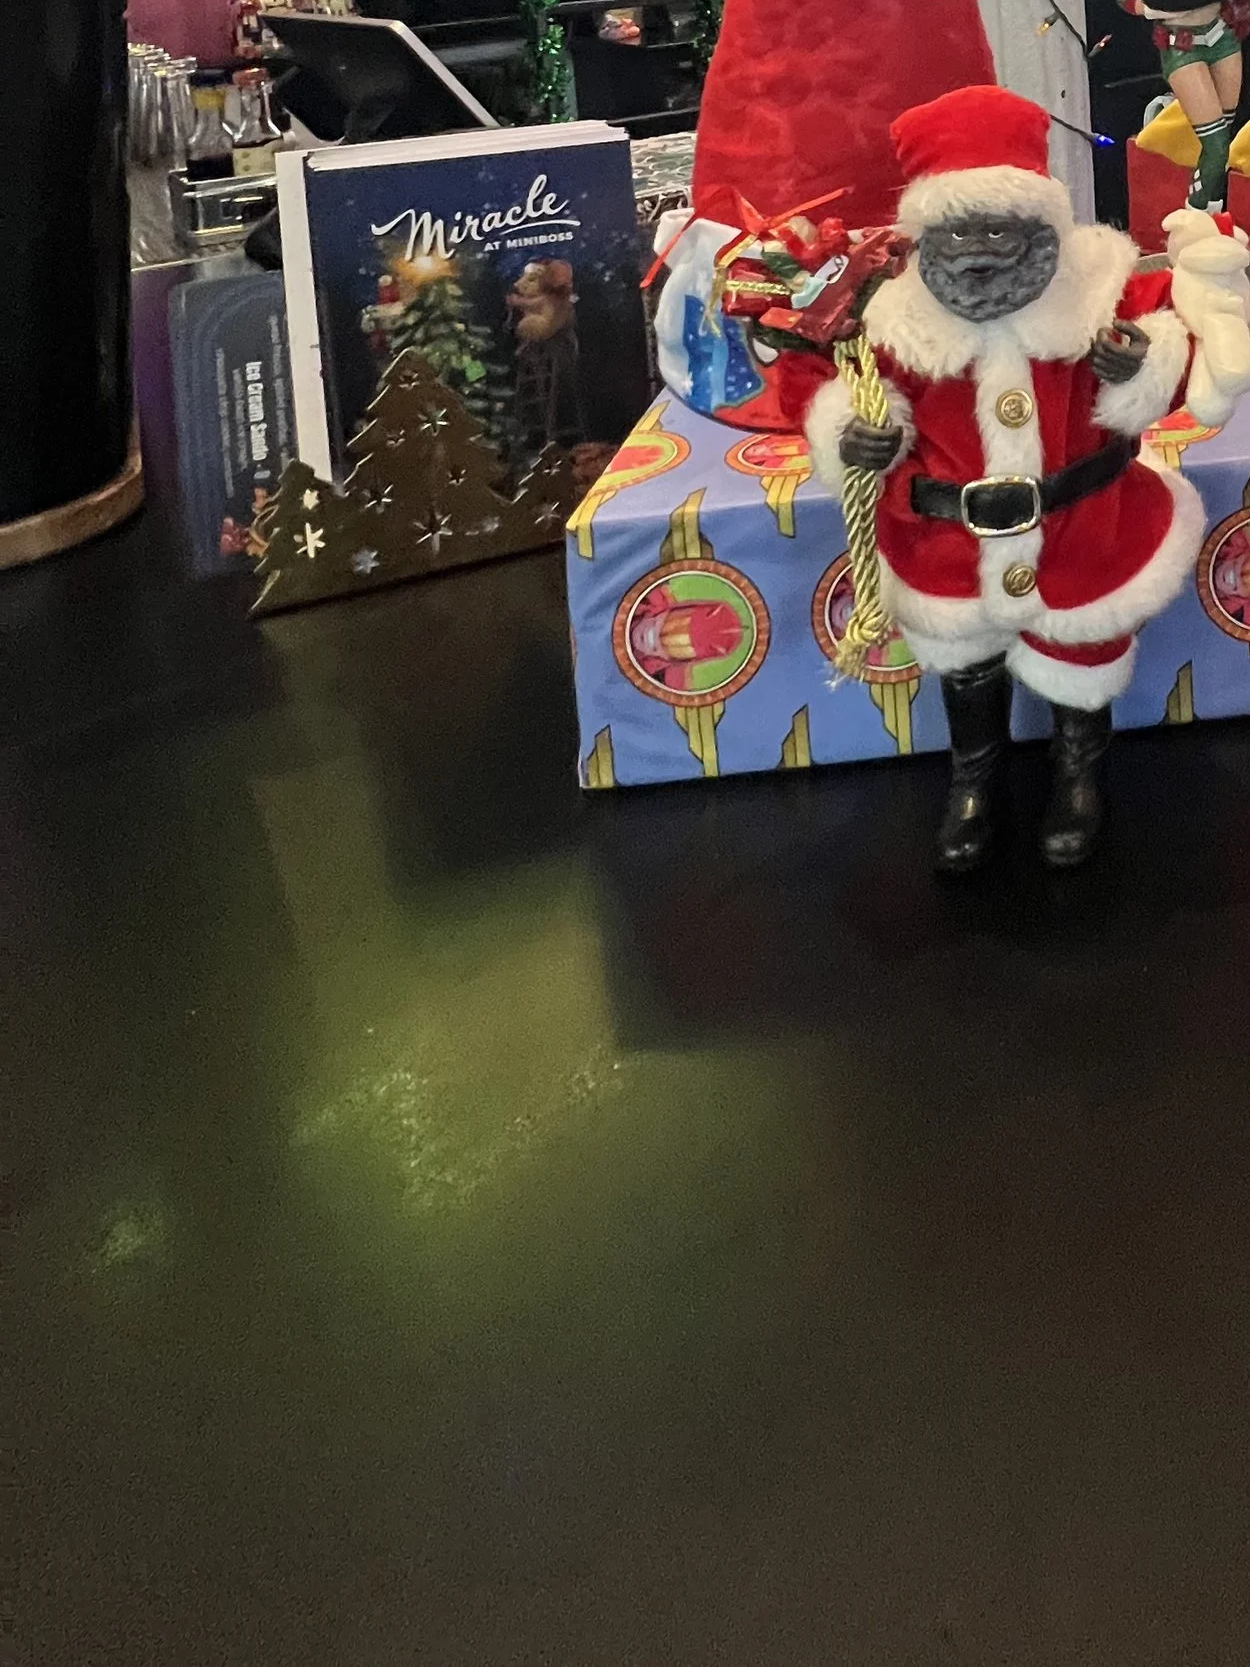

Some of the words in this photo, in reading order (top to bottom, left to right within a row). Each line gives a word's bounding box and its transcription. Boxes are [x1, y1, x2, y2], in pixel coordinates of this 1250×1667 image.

[371, 173, 571, 262] Miracle
[484, 240, 502, 252] AT
[506, 231, 574, 249] MINIBOSS
[245, 360, 263, 381] Ice
[247, 382, 265, 423] Cream
[250, 422, 269, 461] Sando
